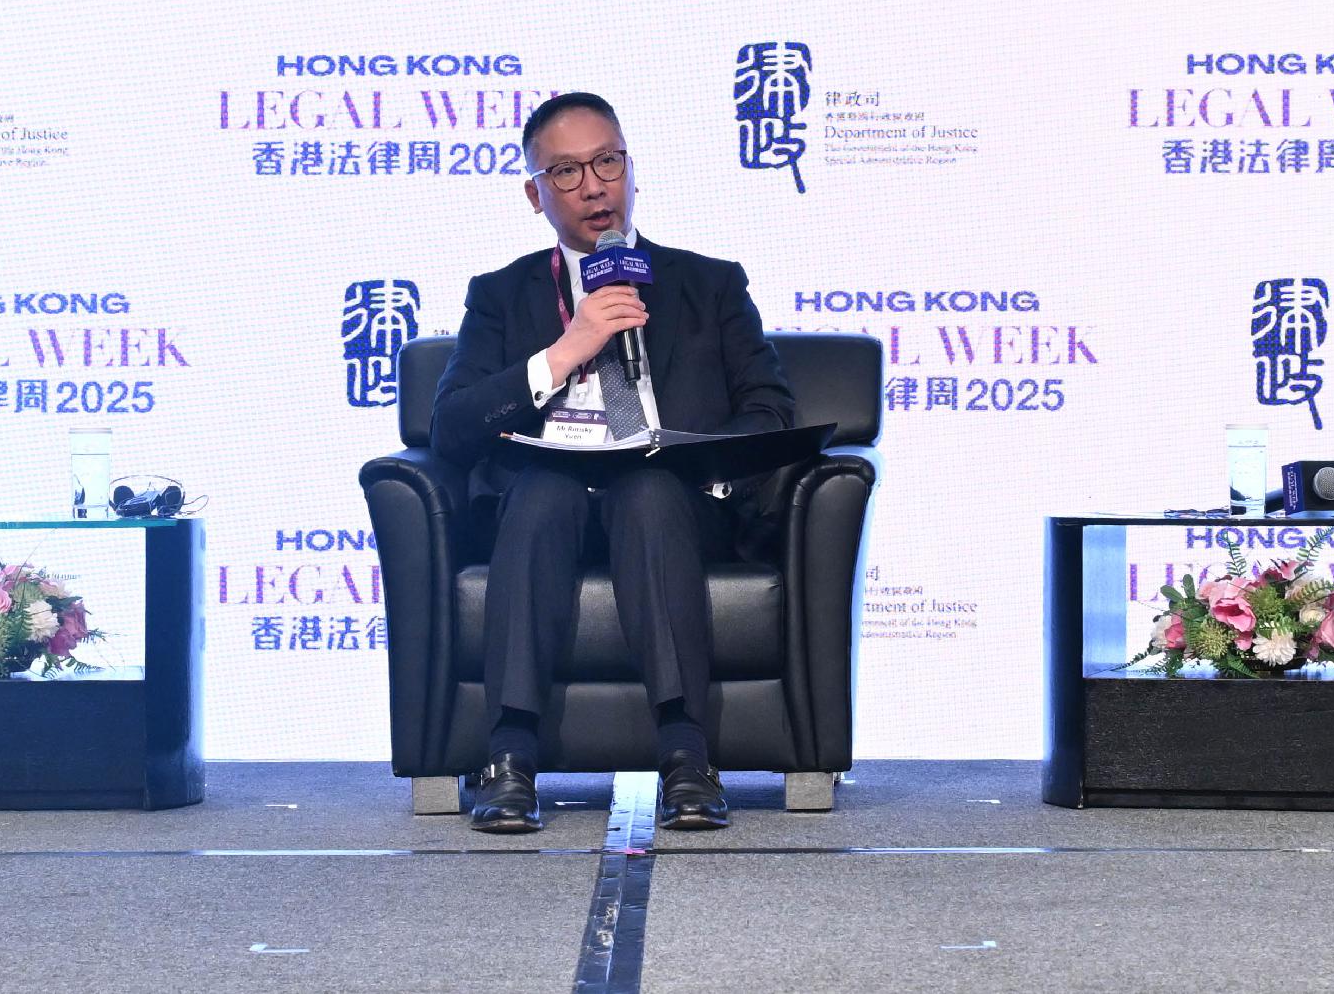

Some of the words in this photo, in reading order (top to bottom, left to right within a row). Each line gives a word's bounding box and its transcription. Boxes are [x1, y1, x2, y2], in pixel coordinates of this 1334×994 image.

[275, 53, 400, 78] HONG
[404, 53, 524, 78] KONG
[1185, 52, 1308, 76] HONG
[217, 90, 404, 130] LEGAL
[418, 90, 560, 130] WEE
[1126, 88, 1313, 128] LEGAL
[251, 140, 524, 176] 香港法律周202
[12, 291, 132, 316] KONG
[793, 290, 917, 313] HONG
[923, 290, 1041, 313] KONG
[27, 327, 192, 369] WEEK
[936, 325, 1100, 366] WEEK
[884, 376, 1066, 412] 律周2025
